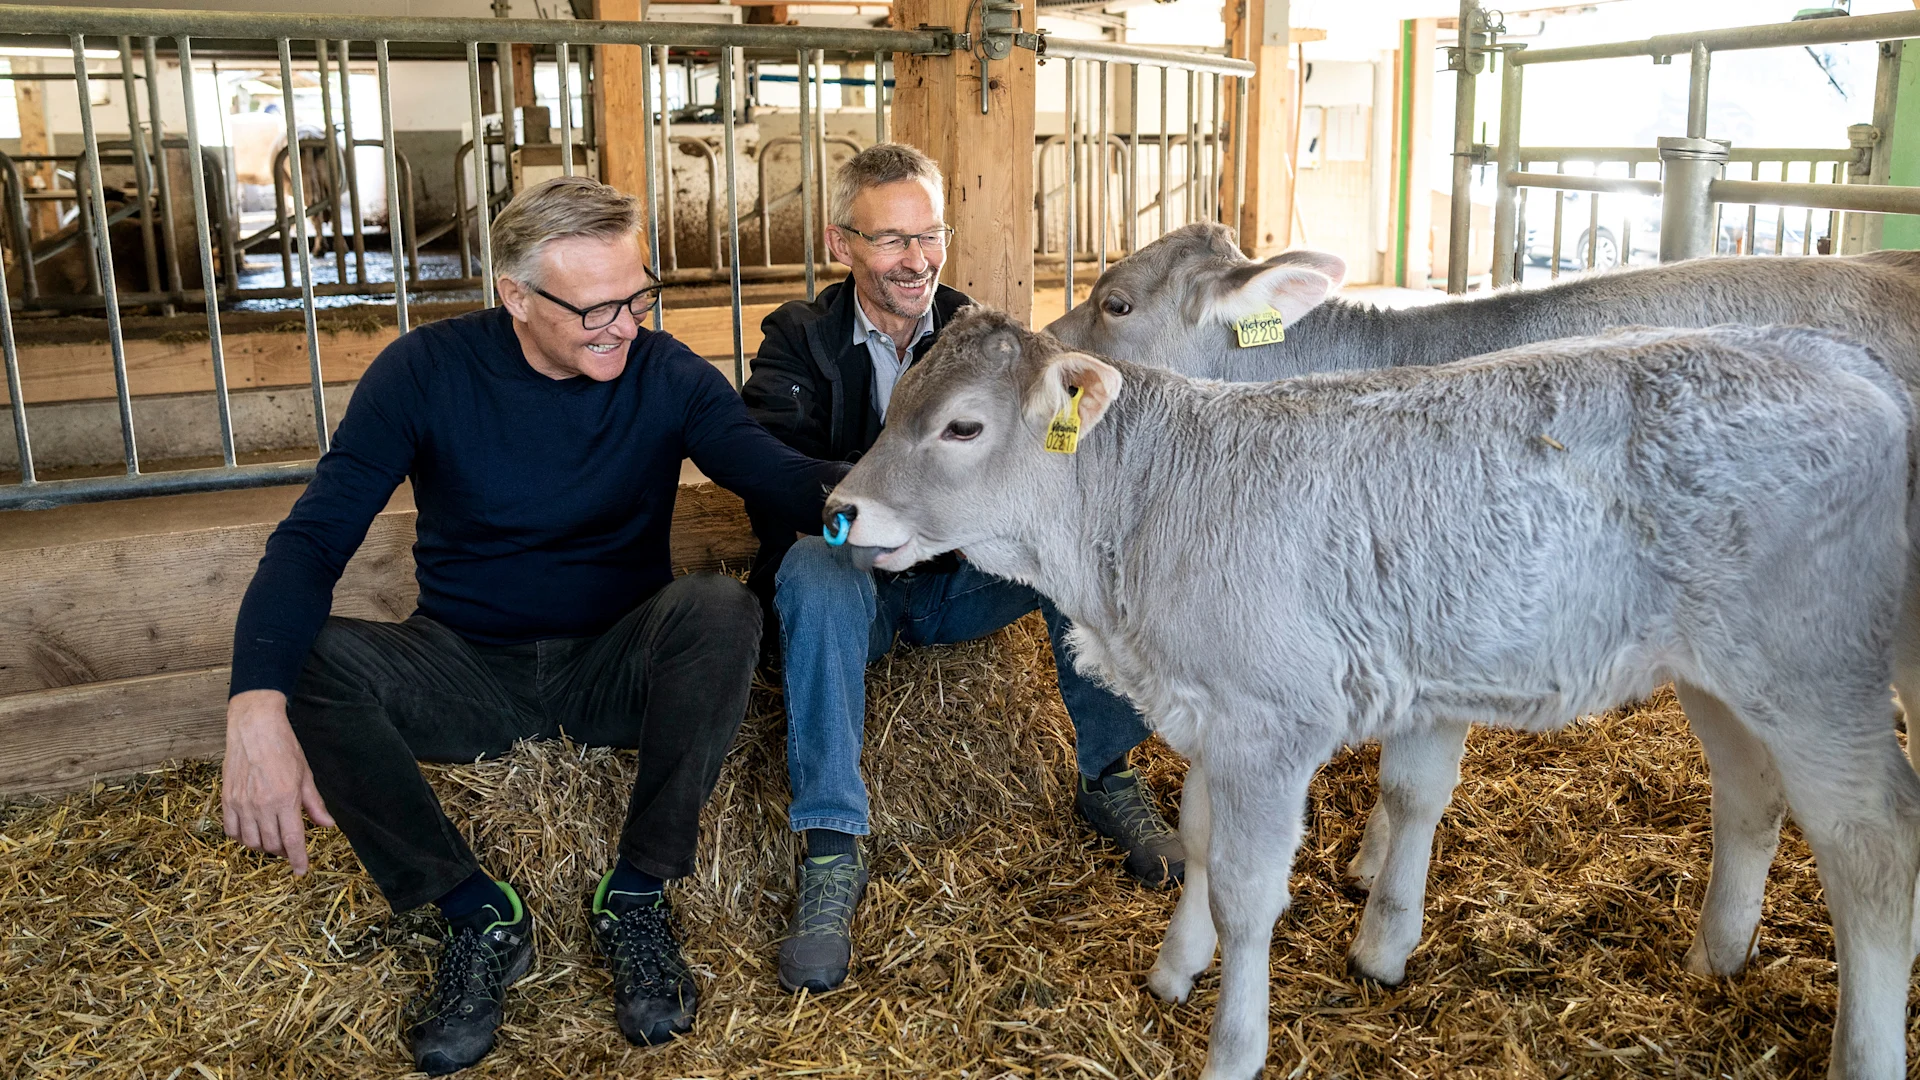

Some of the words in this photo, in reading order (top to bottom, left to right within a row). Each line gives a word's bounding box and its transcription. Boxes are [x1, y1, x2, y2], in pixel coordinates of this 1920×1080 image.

[1238, 316, 1282, 331] Victoria
[1241, 326, 1278, 344] 0220
[1046, 432, 1071, 451] 0221
